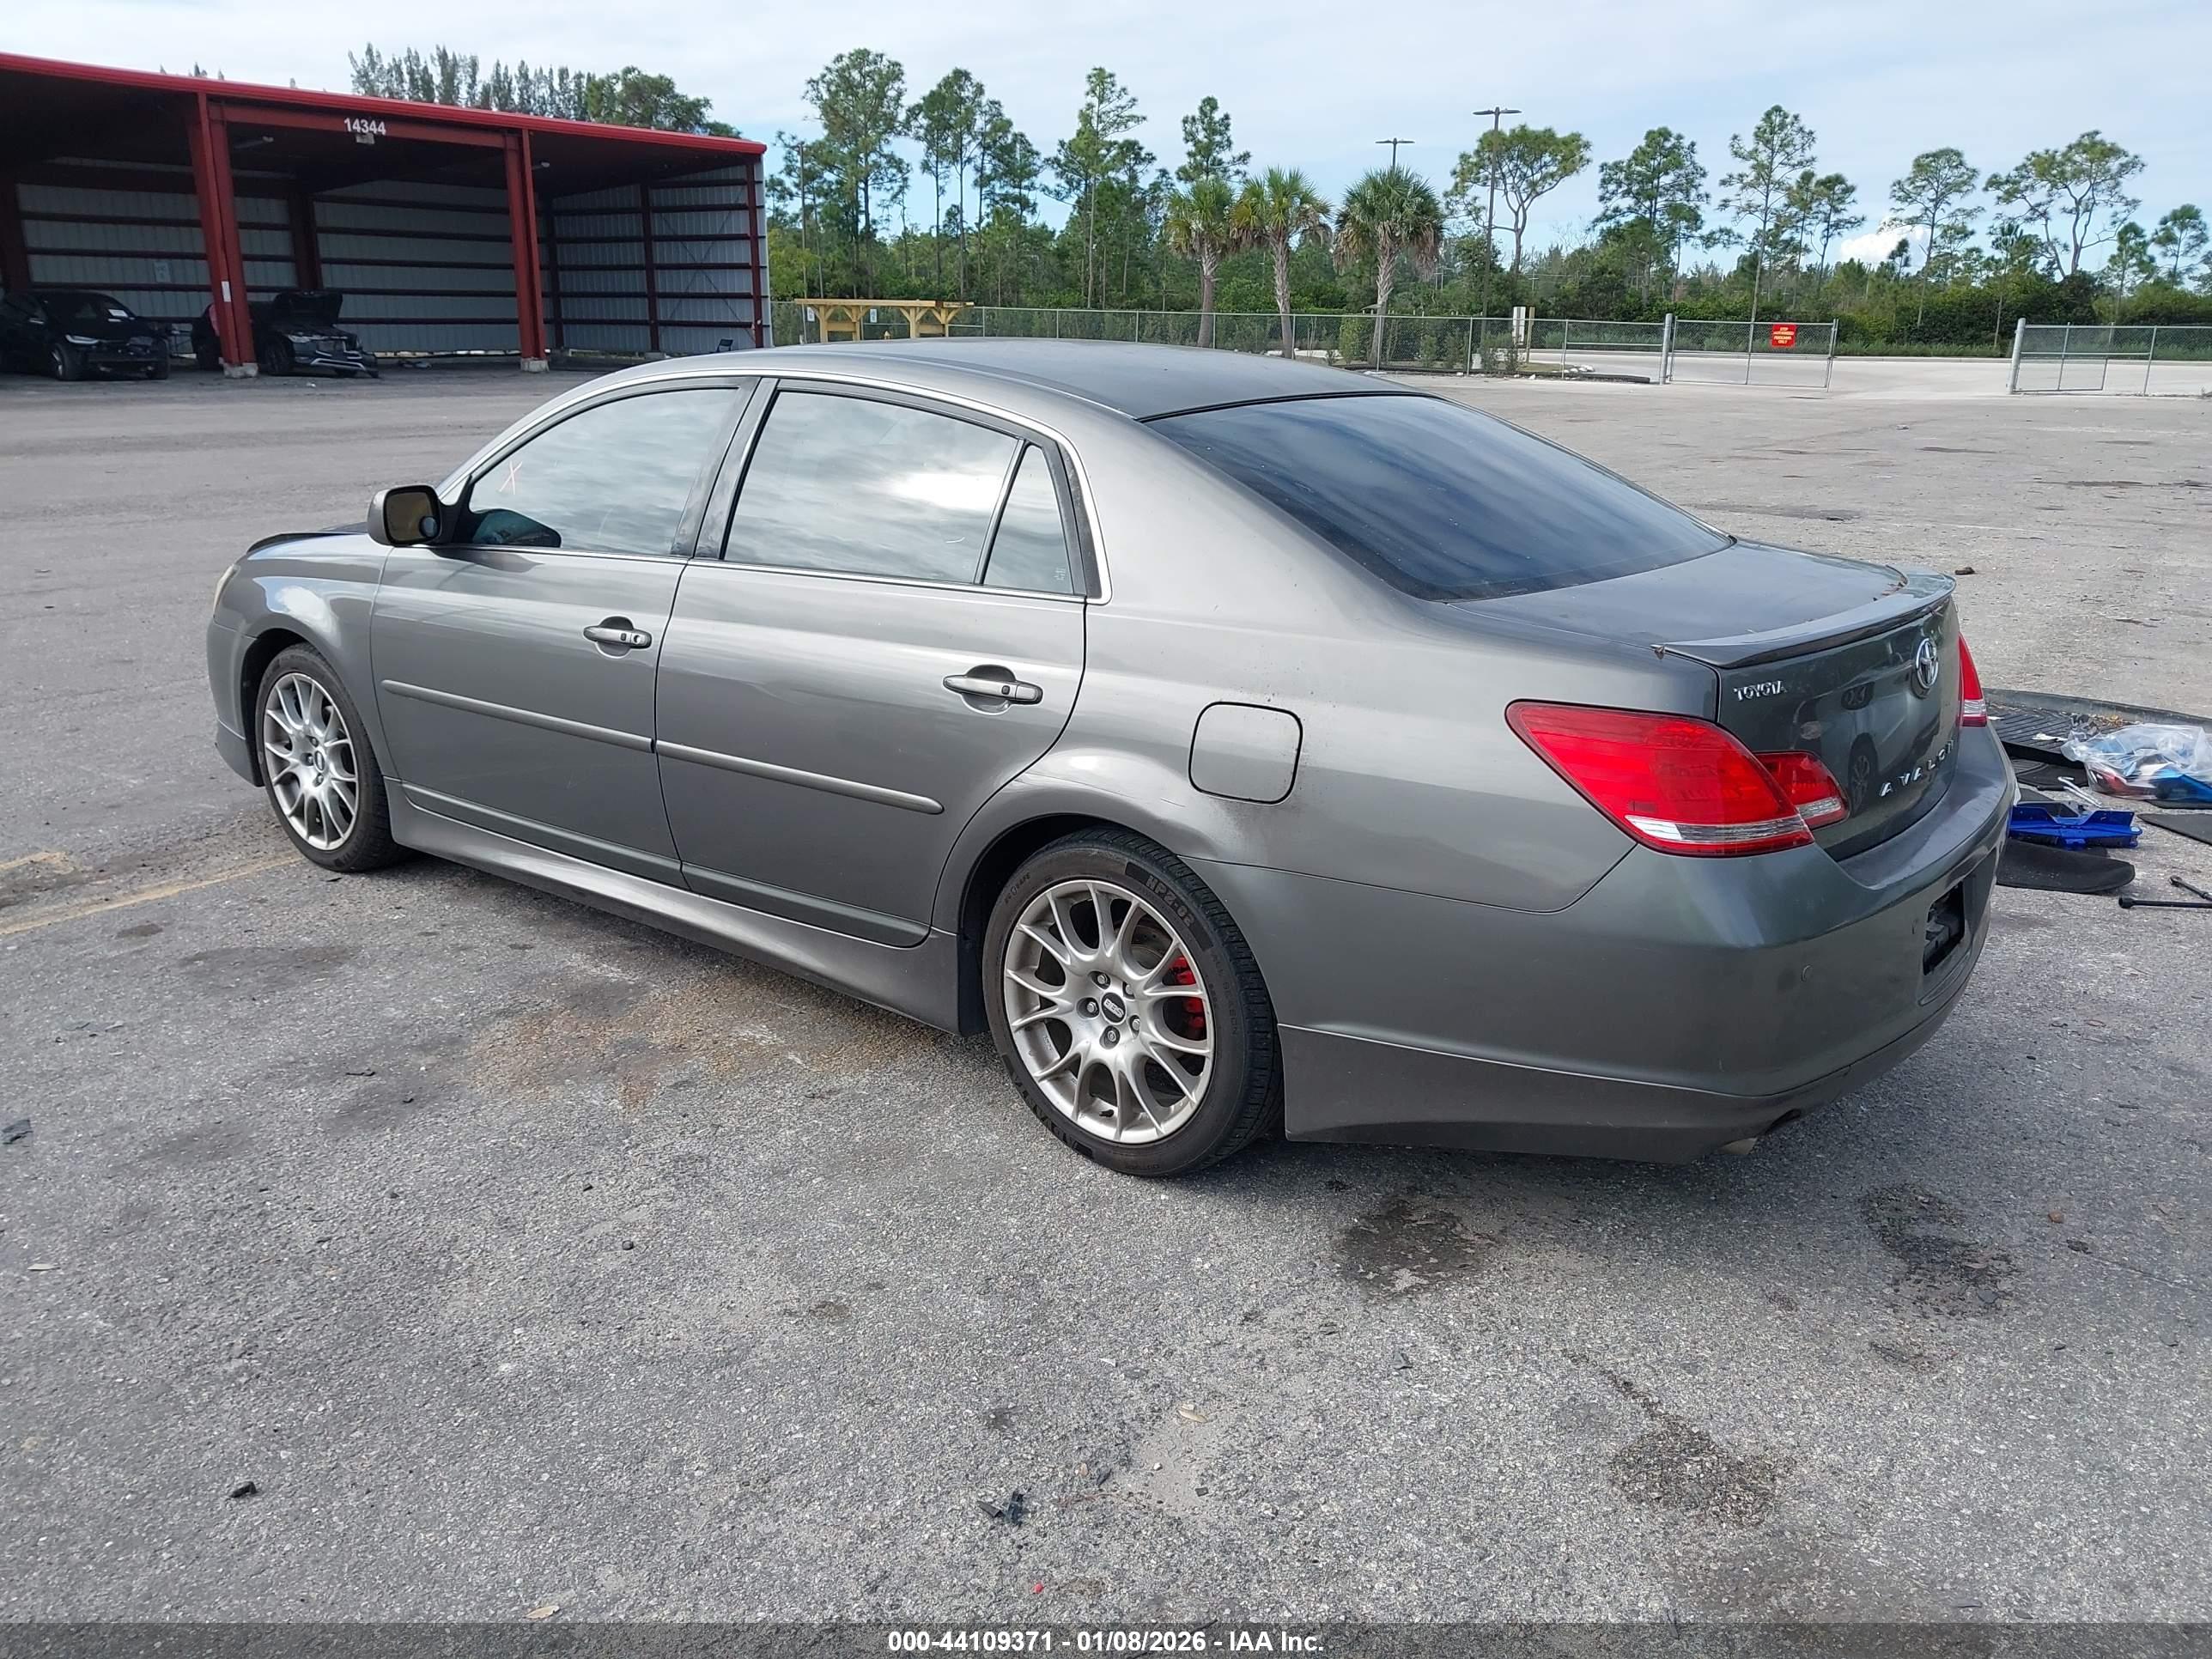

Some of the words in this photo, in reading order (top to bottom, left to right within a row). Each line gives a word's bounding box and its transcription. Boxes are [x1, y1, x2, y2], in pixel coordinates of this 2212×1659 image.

[343, 117, 386, 136] 14344
[1733, 680, 1788, 702] TOYOTA
[1103, 998, 1124, 1018] BBS
